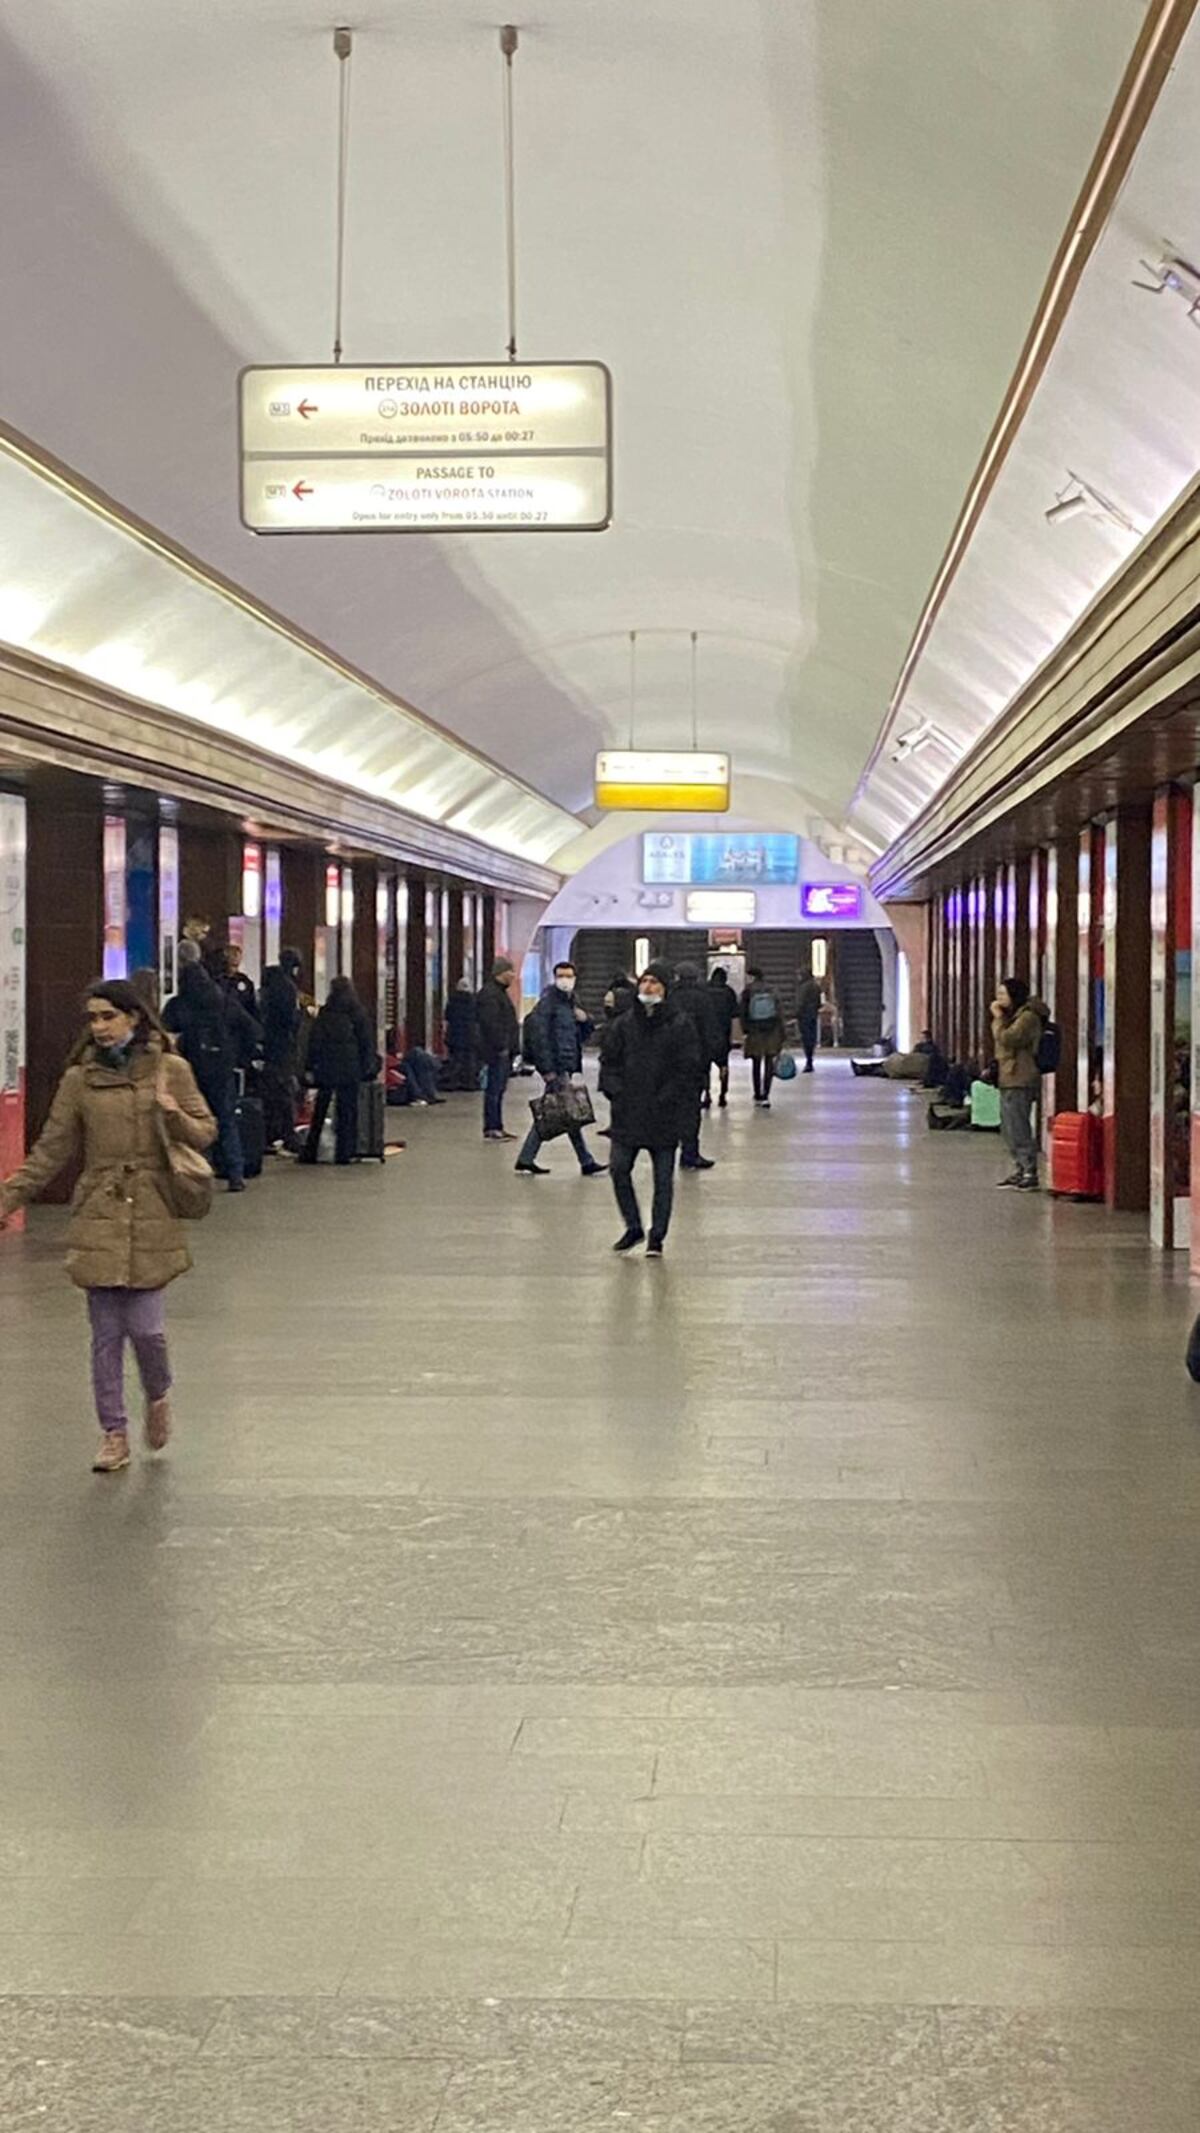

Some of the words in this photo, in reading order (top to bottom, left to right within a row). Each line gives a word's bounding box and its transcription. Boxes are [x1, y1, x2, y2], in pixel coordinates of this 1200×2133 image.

[365, 376, 431, 392] ПЕРЕХІД
[434, 376, 455, 390] НА
[458, 374, 532, 391] СТАНЦІЮ
[400, 400, 455, 416] ЗОЛОТІ
[459, 400, 521, 416] ВОРОТА
[416, 467, 474, 479] PASSAGE
[478, 466, 496, 479] TO
[388, 488, 432, 501] ZOLOTI
[435, 487, 485, 499] VOROTA
[487, 487, 535, 499] STATION
